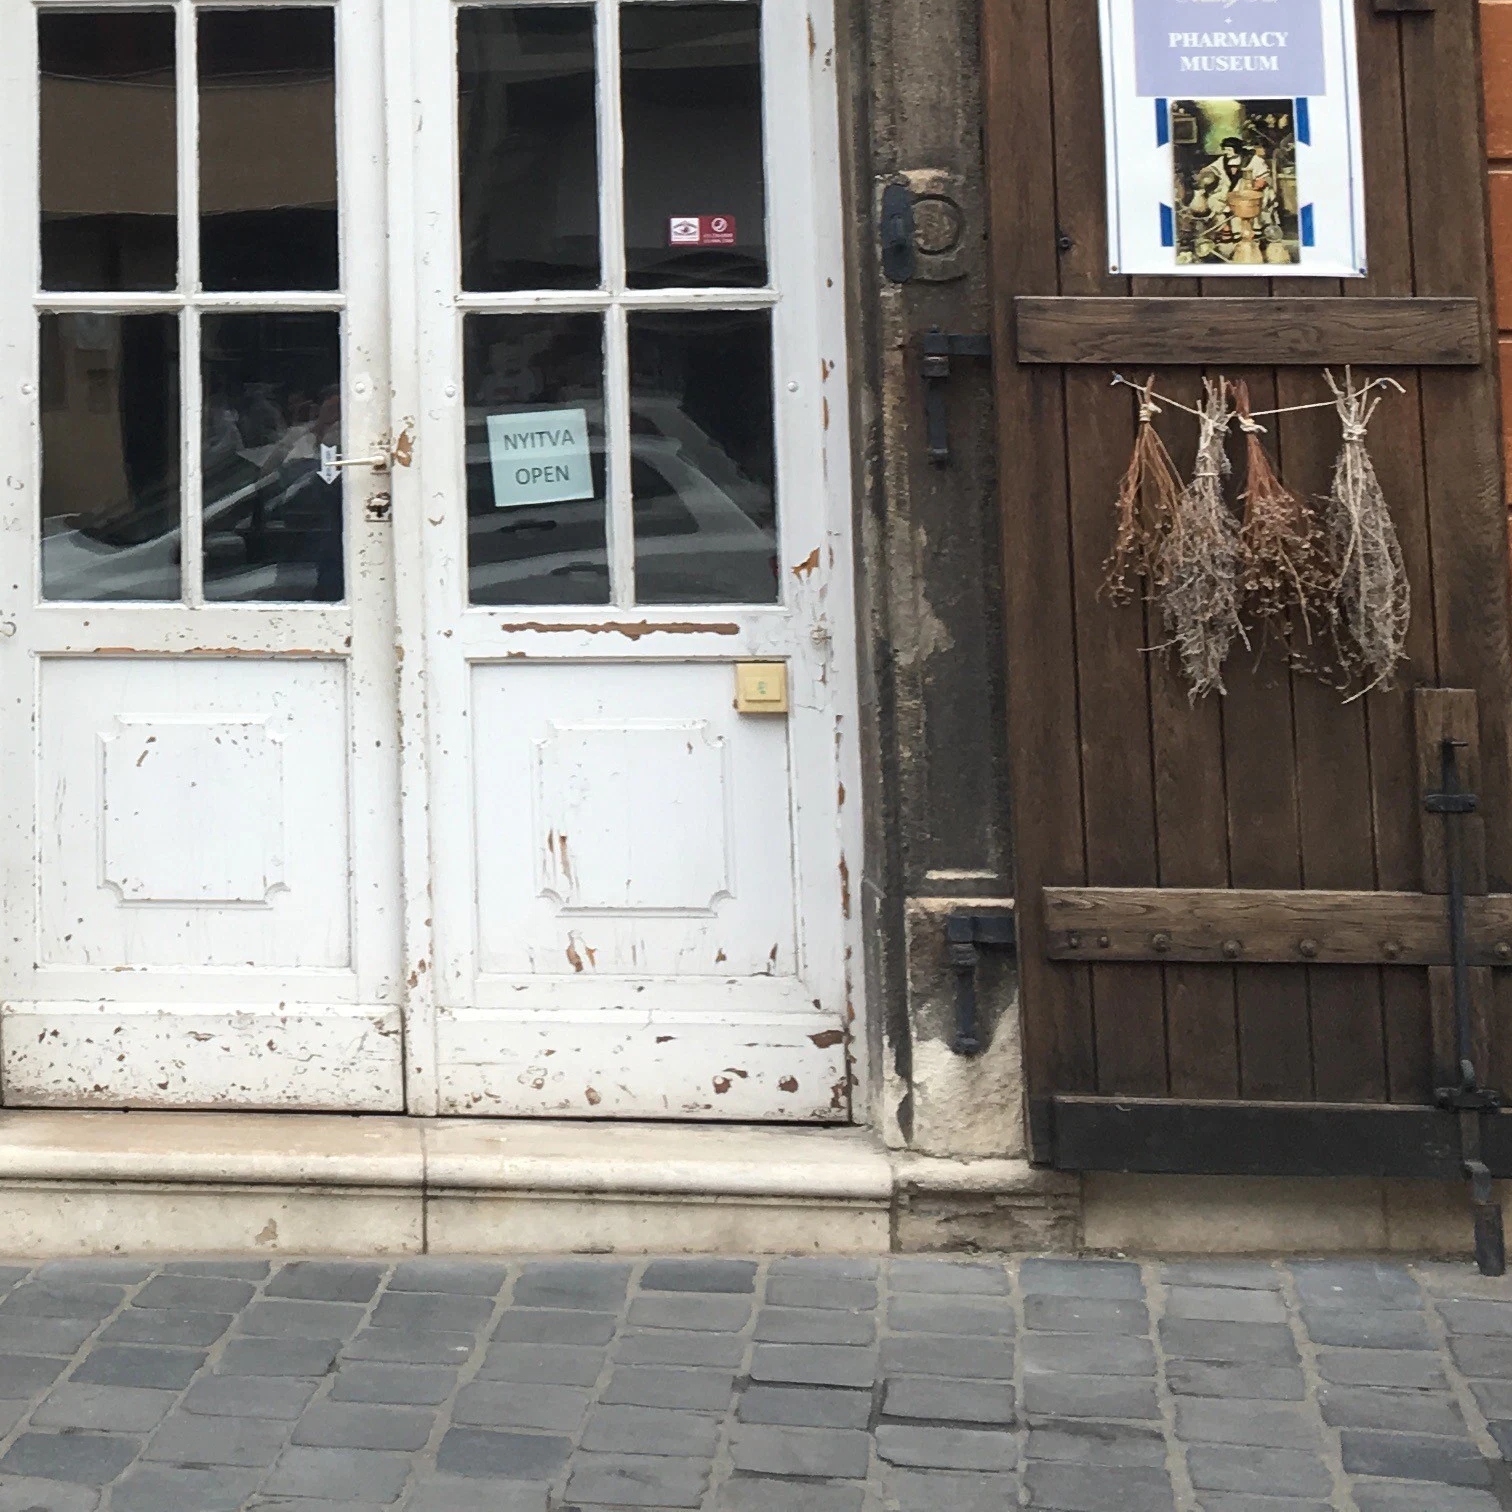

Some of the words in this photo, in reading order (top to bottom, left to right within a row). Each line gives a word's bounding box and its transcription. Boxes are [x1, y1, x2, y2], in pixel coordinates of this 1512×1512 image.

[1168, 31, 1289, 48] PHARMACY
[1180, 55, 1280, 72] MUSEUM
[503, 429, 576, 450] NYITVA
[515, 465, 570, 485] OPEN
